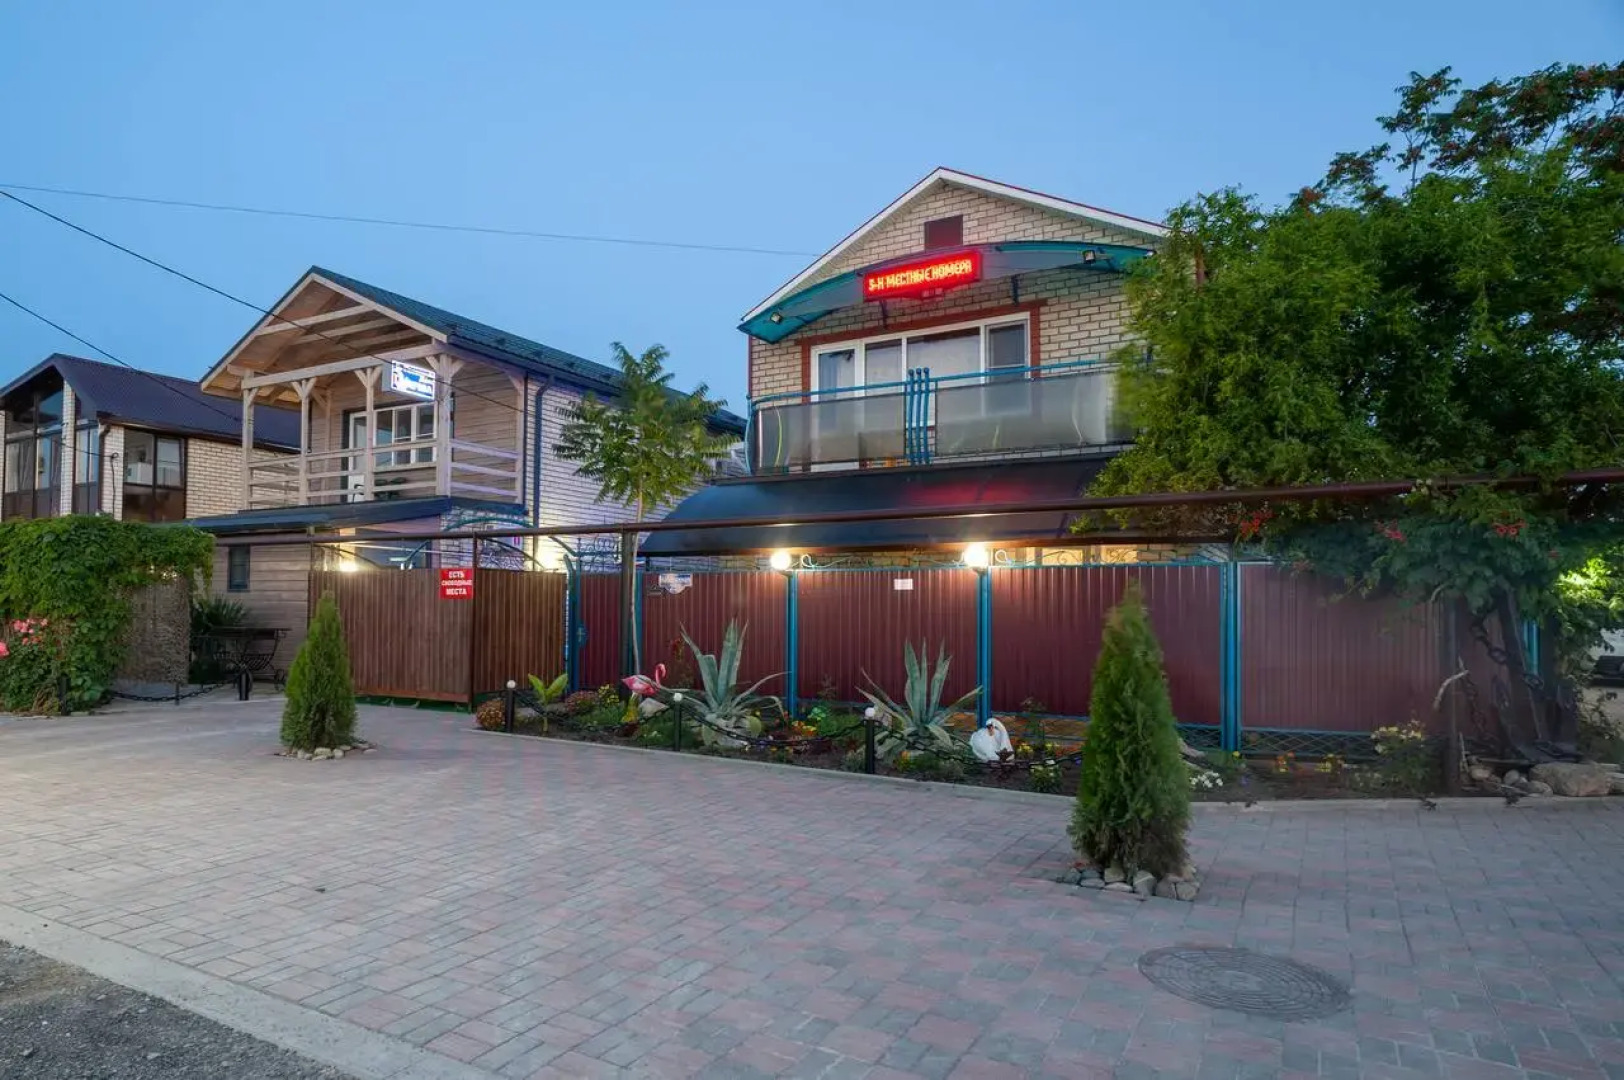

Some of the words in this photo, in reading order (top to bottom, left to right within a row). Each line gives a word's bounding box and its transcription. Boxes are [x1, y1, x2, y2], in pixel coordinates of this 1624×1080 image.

[886, 267, 932, 288] МЕСТНЫЕ
[932, 259, 972, 280] НОМЕРА
[448, 570, 465, 578] ЕСТЬ
